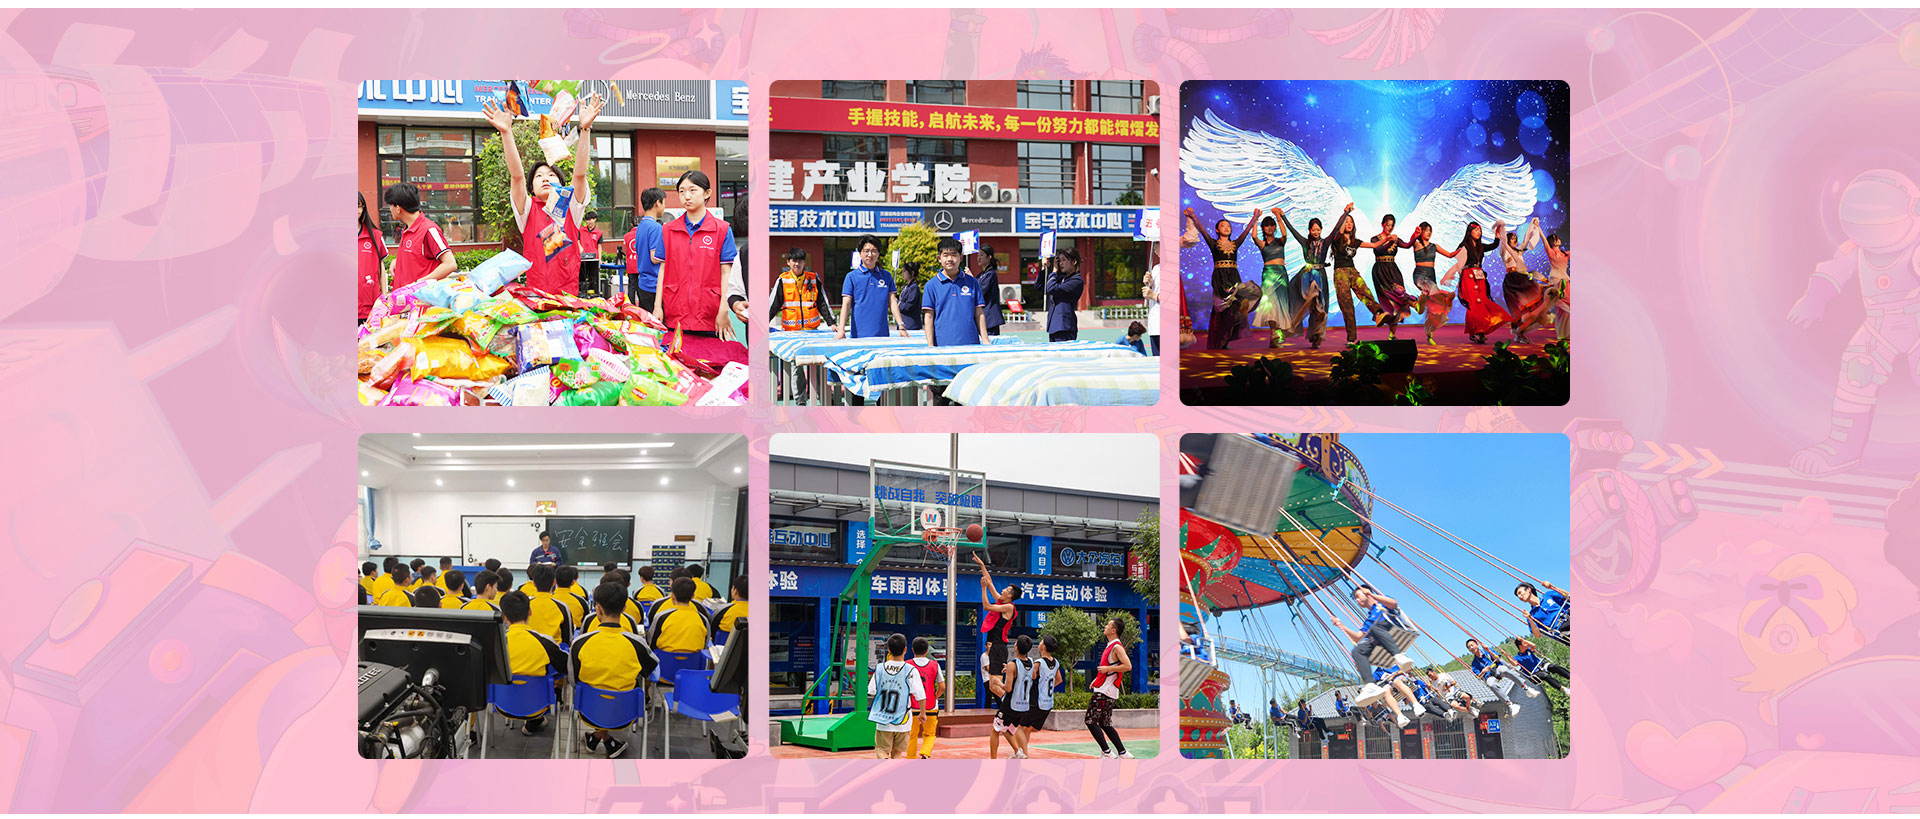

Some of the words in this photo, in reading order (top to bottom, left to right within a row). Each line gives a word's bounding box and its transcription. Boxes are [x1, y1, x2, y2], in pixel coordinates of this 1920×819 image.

[626, 89, 670, 101] Mercedes
[675, 91, 695, 103] Benz
[1024, 212, 1122, 230] 宝马技术中心
[555, 527, 624, 551] 安全班会
[1020, 582, 1108, 603] 汽车启动体验
[881, 690, 899, 714] 10
